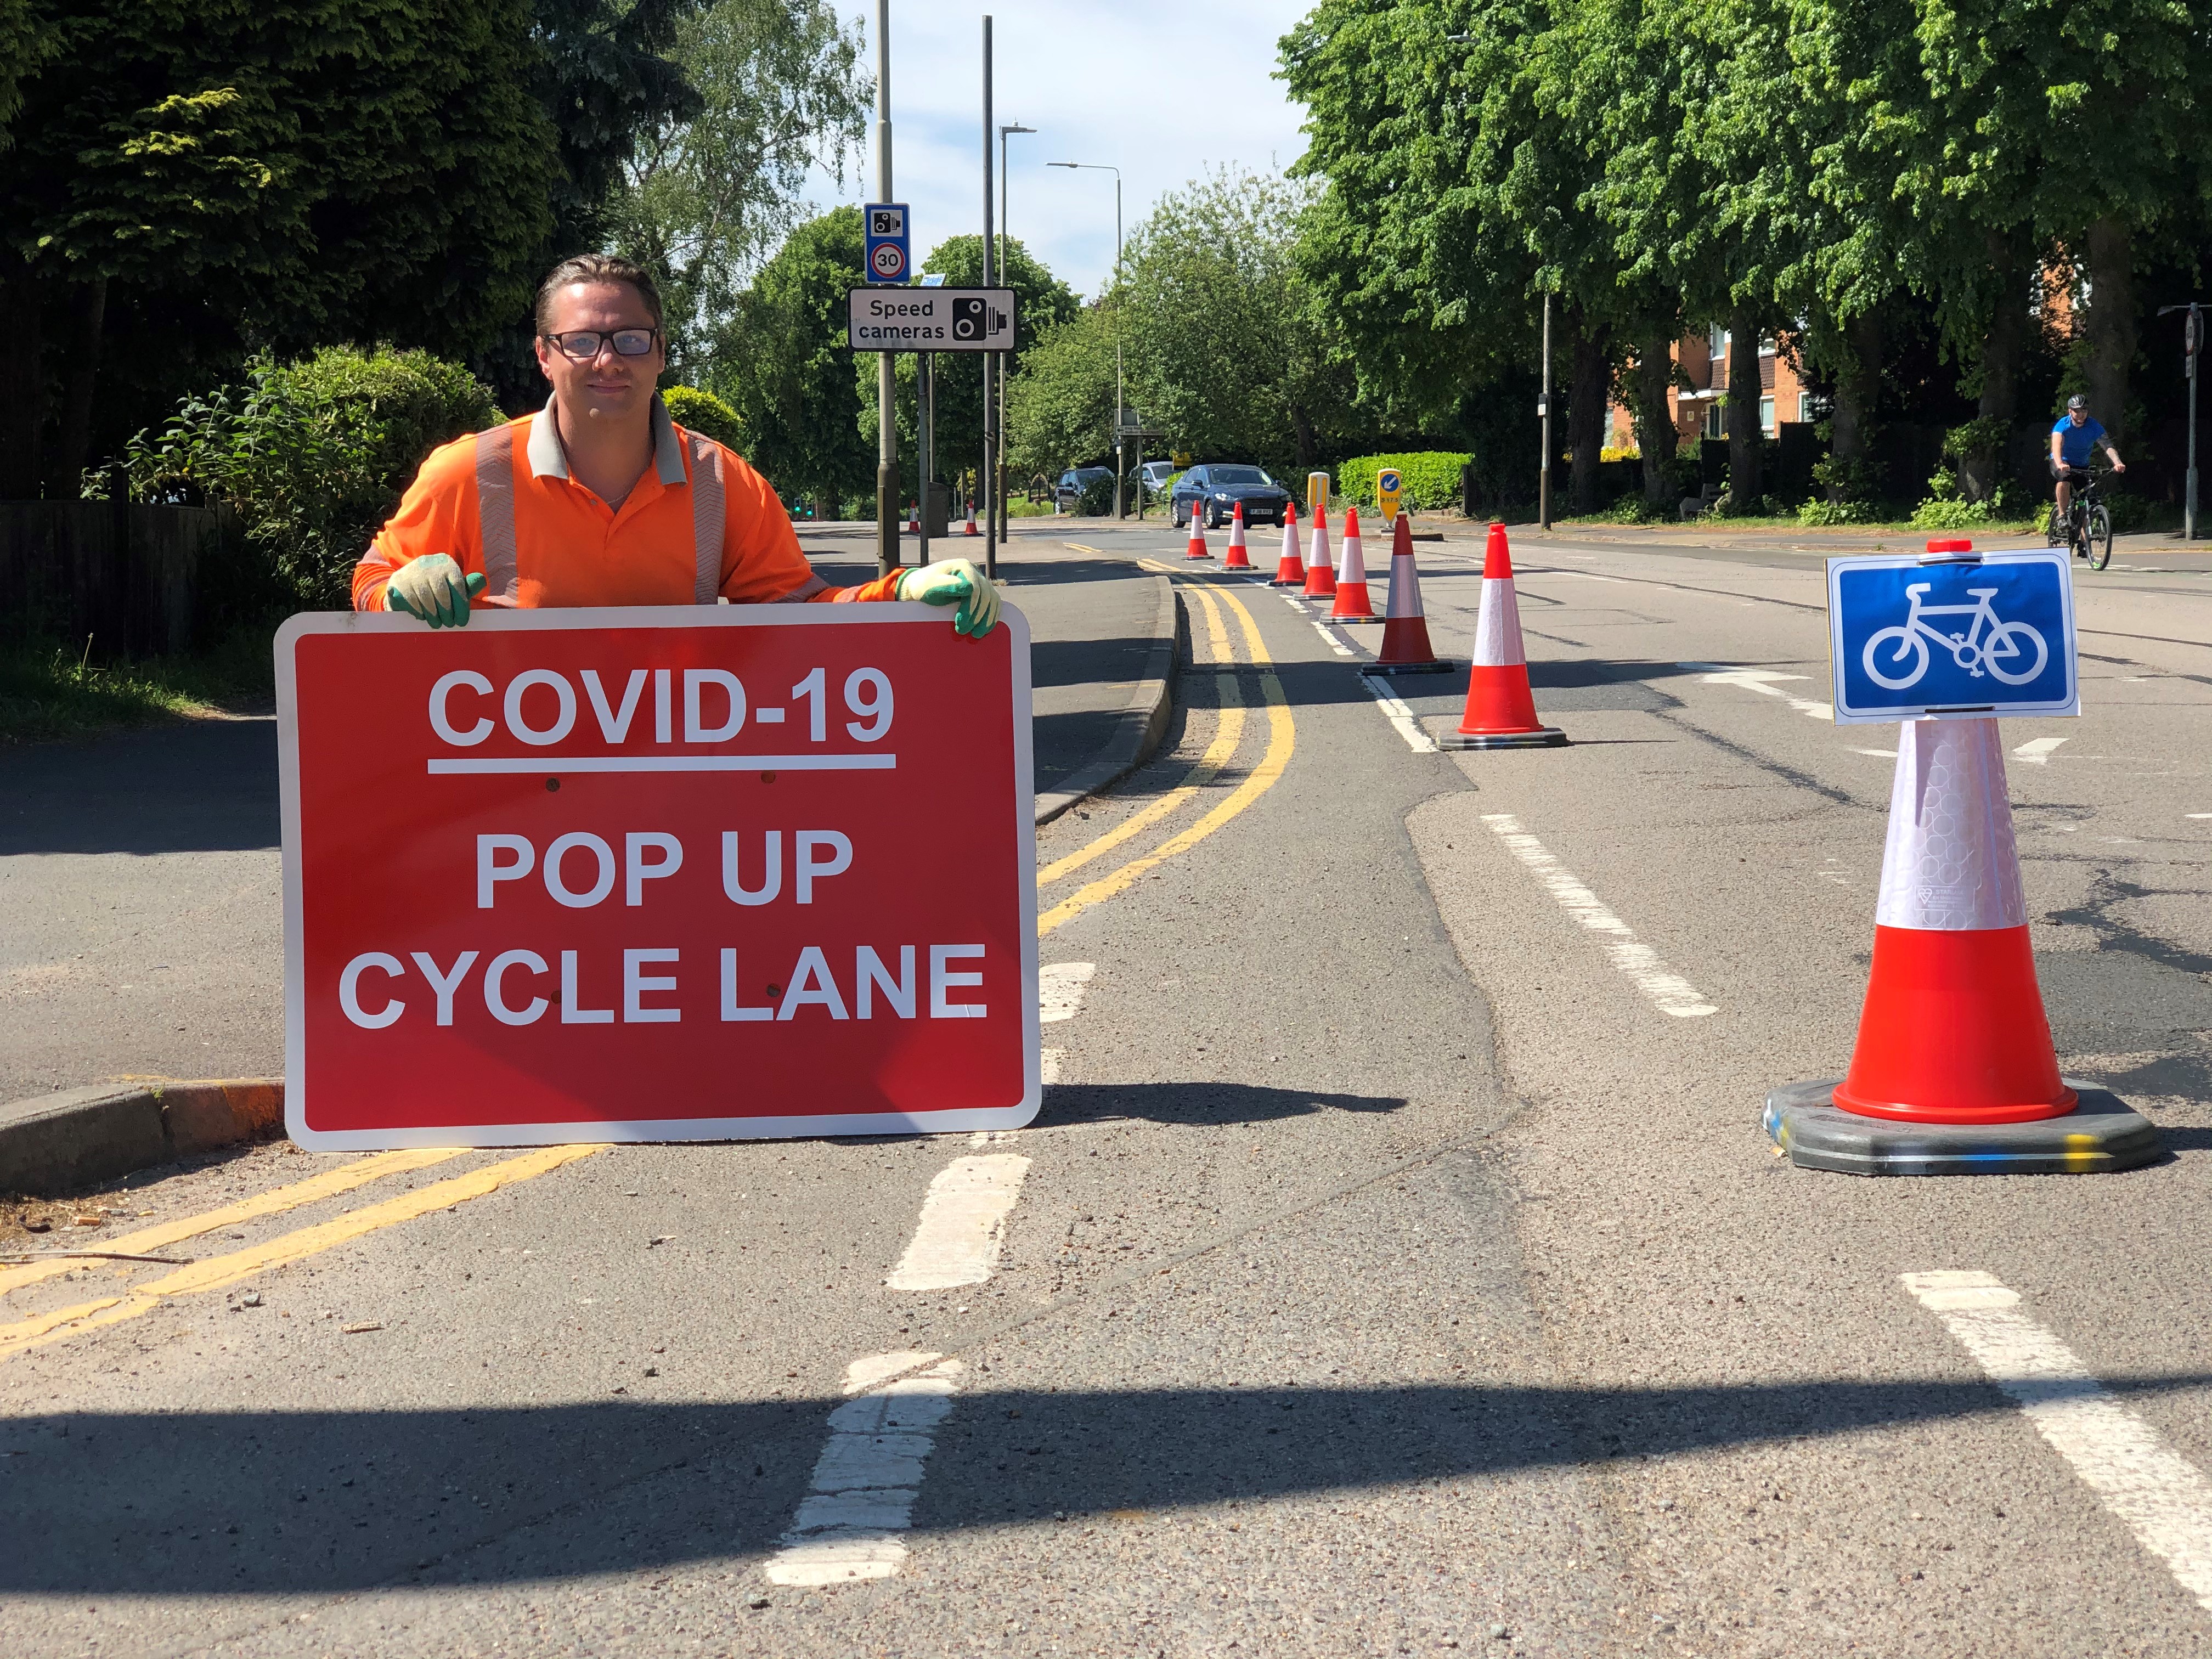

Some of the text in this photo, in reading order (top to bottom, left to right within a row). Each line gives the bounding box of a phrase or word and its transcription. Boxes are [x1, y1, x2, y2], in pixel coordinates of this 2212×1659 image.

[878, 254, 898, 266] 30
[859, 326, 945, 339] cameras
[870, 300, 933, 319] Speed
[428, 667, 894, 747] COVID-19
[477, 830, 853, 909] POP UP
[339, 944, 987, 1029] CYCLE LANE
